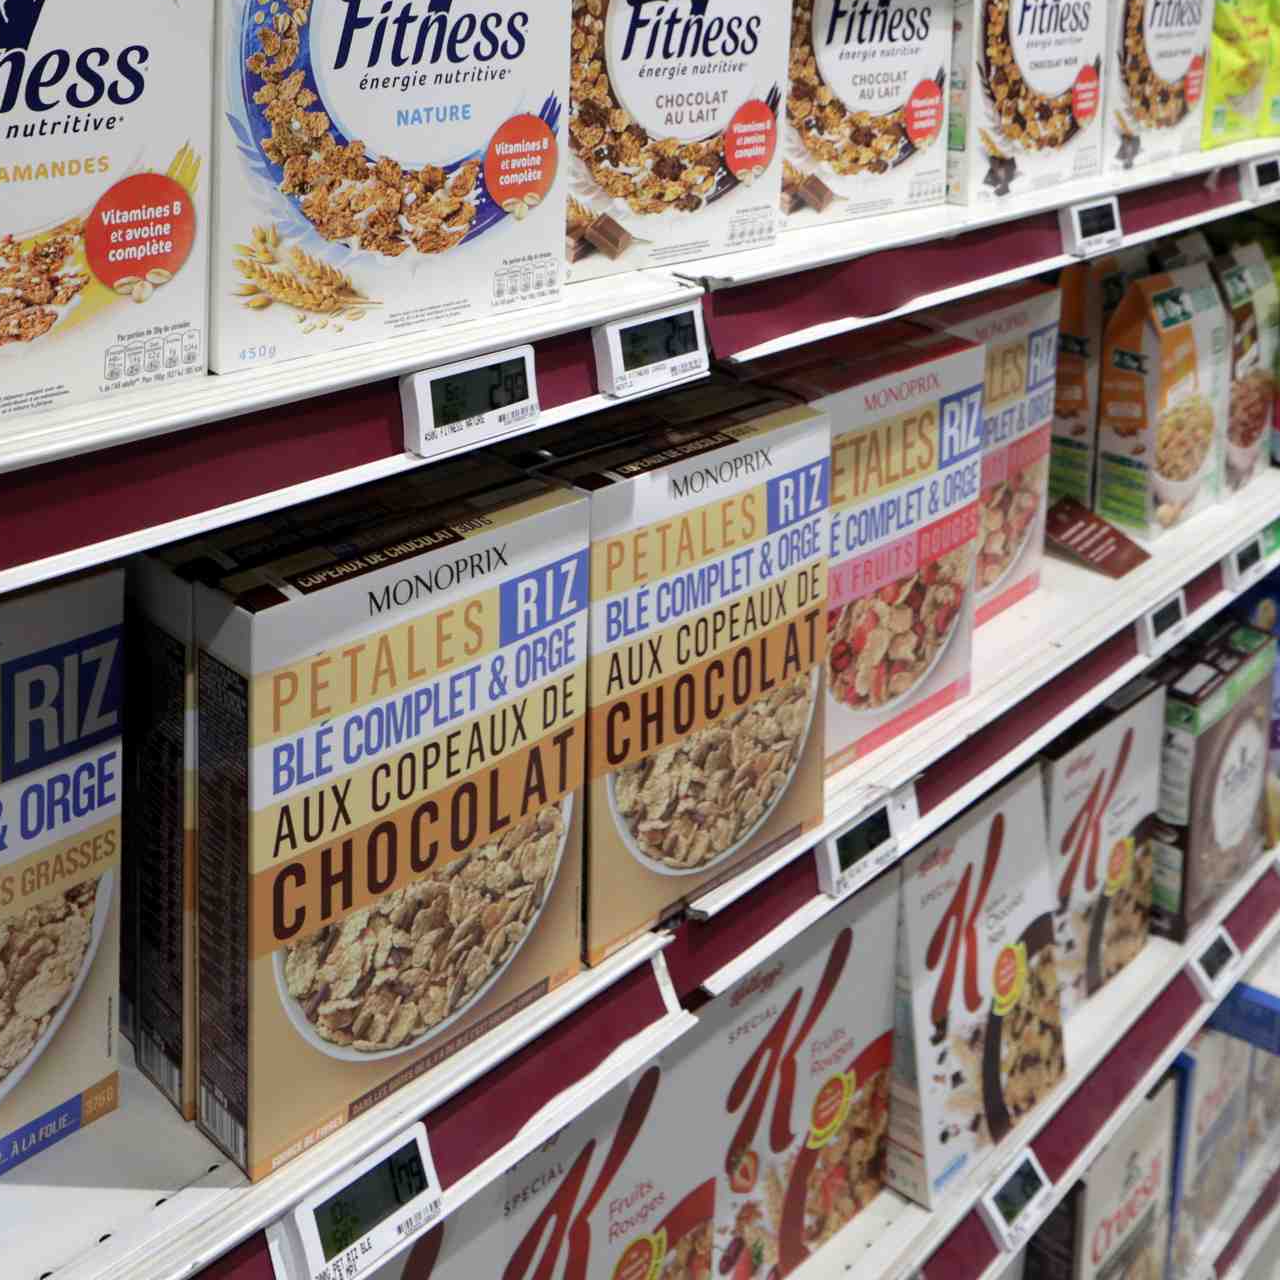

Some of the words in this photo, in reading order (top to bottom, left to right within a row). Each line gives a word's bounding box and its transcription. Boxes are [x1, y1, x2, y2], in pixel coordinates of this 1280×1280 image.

[359, 70, 427, 91] énergie
[655, 90, 728, 110] CHOCOLAT
[851, 71, 908, 87] CHOCOLAT
[858, 88, 874, 101] AU
[878, 86, 901, 99] LAIT
[396, 104, 471, 128] NATURE
[665, 111, 687, 126] AU
[691, 108, 718, 123] LAIT
[495, 141, 541, 155] Vitamines
[101, 204, 169, 226] Vitamines
[110, 230, 122, 243] et
[125, 221, 171, 242] avoine
[108, 238, 173, 263] complète
[239, 344, 277, 362] 450g
[862, 372, 940, 412] MONOPRIX
[671, 448, 775, 499] MONOPRIX
[831, 406, 936, 505] ÉTALES
[942, 390, 983, 465] RIZ
[605, 492, 757, 593] PÉTALES
[778, 464, 822, 527] RIZ
[846, 483, 925, 556] COMPLET
[927, 478, 940, 514] &
[943, 459, 979, 505] ORGE
[367, 543, 509, 617] MONOPRIX
[606, 585, 650, 644] BLÉ
[656, 548, 753, 623] COMPLET
[759, 543, 772, 580] &
[777, 518, 822, 568] ORGE
[851, 539, 914, 595] FRUITS
[272, 599, 485, 733] PÉTALES
[516, 558, 579, 635] RIZ
[606, 635, 662, 696] AUX
[676, 575, 787, 667] COPEAUX
[797, 563, 822, 603] DE
[12, 636, 119, 766] RIZ
[272, 721, 334, 796] BLÉ
[343, 665, 481, 766] COMPLET
[487, 654, 508, 701] &
[515, 620, 577, 686] ORGE
[605, 607, 821, 765] CHOCOLAT
[272, 777, 352, 859] AUX
[371, 698, 528, 814] COPEAUX
[542, 673, 575, 727] DE
[20, 750, 117, 841] ORGE
[21, 828, 117, 896] GRASSES
[271, 726, 575, 942] CHOCOLAT
[502, 1162, 566, 1218] SPECIAL
[608, 1191, 666, 1245] Rouges
[609, 1180, 655, 1218] Fruits
